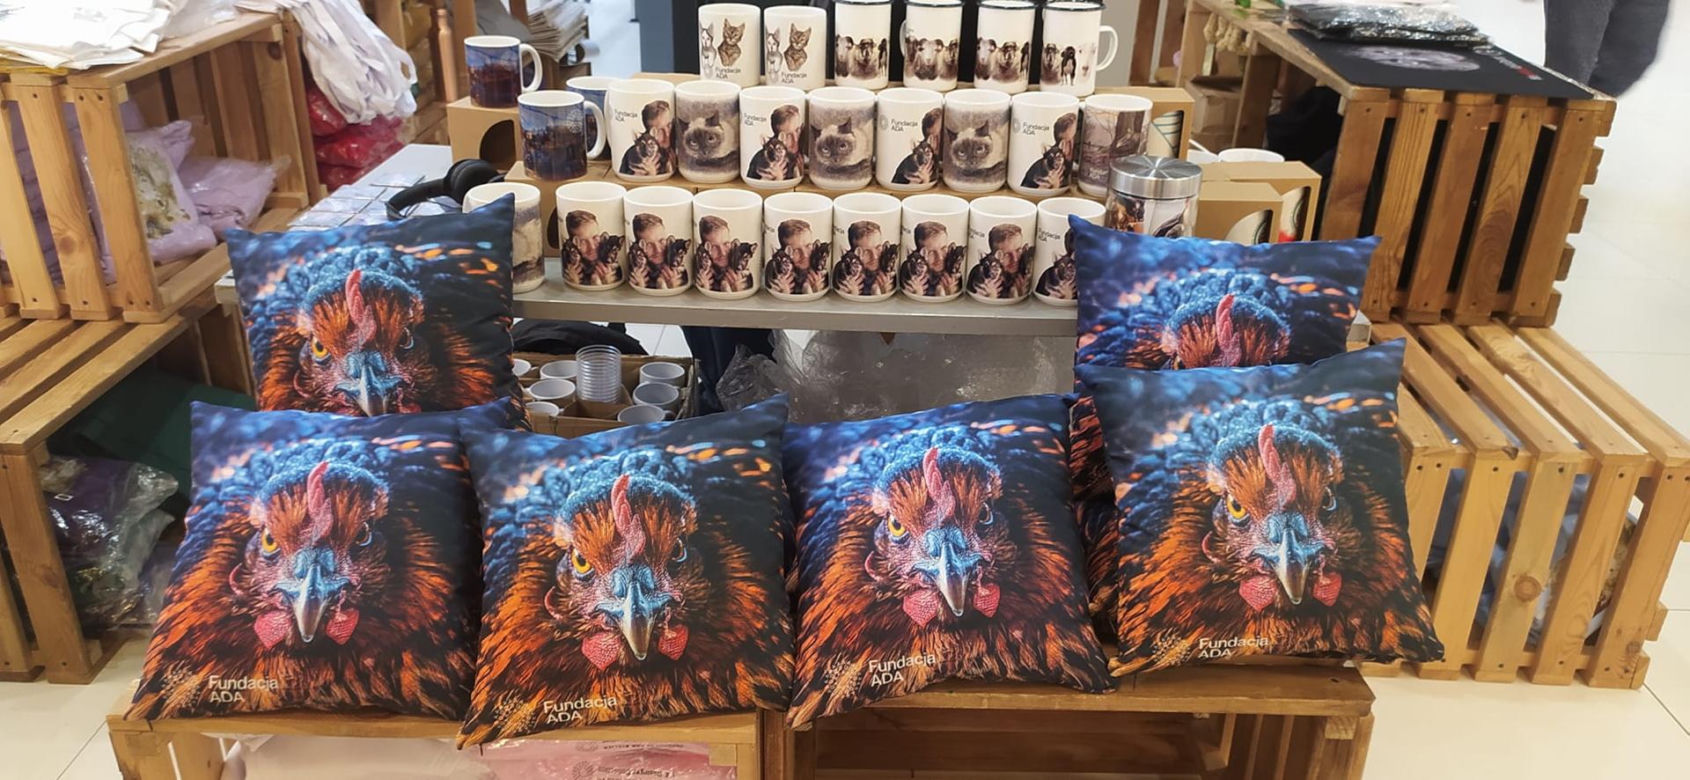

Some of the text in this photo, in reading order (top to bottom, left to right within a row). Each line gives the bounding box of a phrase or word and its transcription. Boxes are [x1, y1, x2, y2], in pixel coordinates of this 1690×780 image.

[715, 66, 741, 74] Fundacja
[781, 71, 807, 79] Fundacja
[890, 118, 918, 127] Fundacja
[1023, 121, 1049, 131] Fundacja
[1198, 635, 1269, 650] Fundacja
[1198, 648, 1232, 659] ADA
[868, 652, 936, 674] Fundacja
[208, 674, 279, 691] Fundacja
[871, 670, 904, 687] ADA
[209, 690, 246, 703] ADA
[543, 695, 617, 714] Fundacja
[546, 710, 582, 724] ADA
